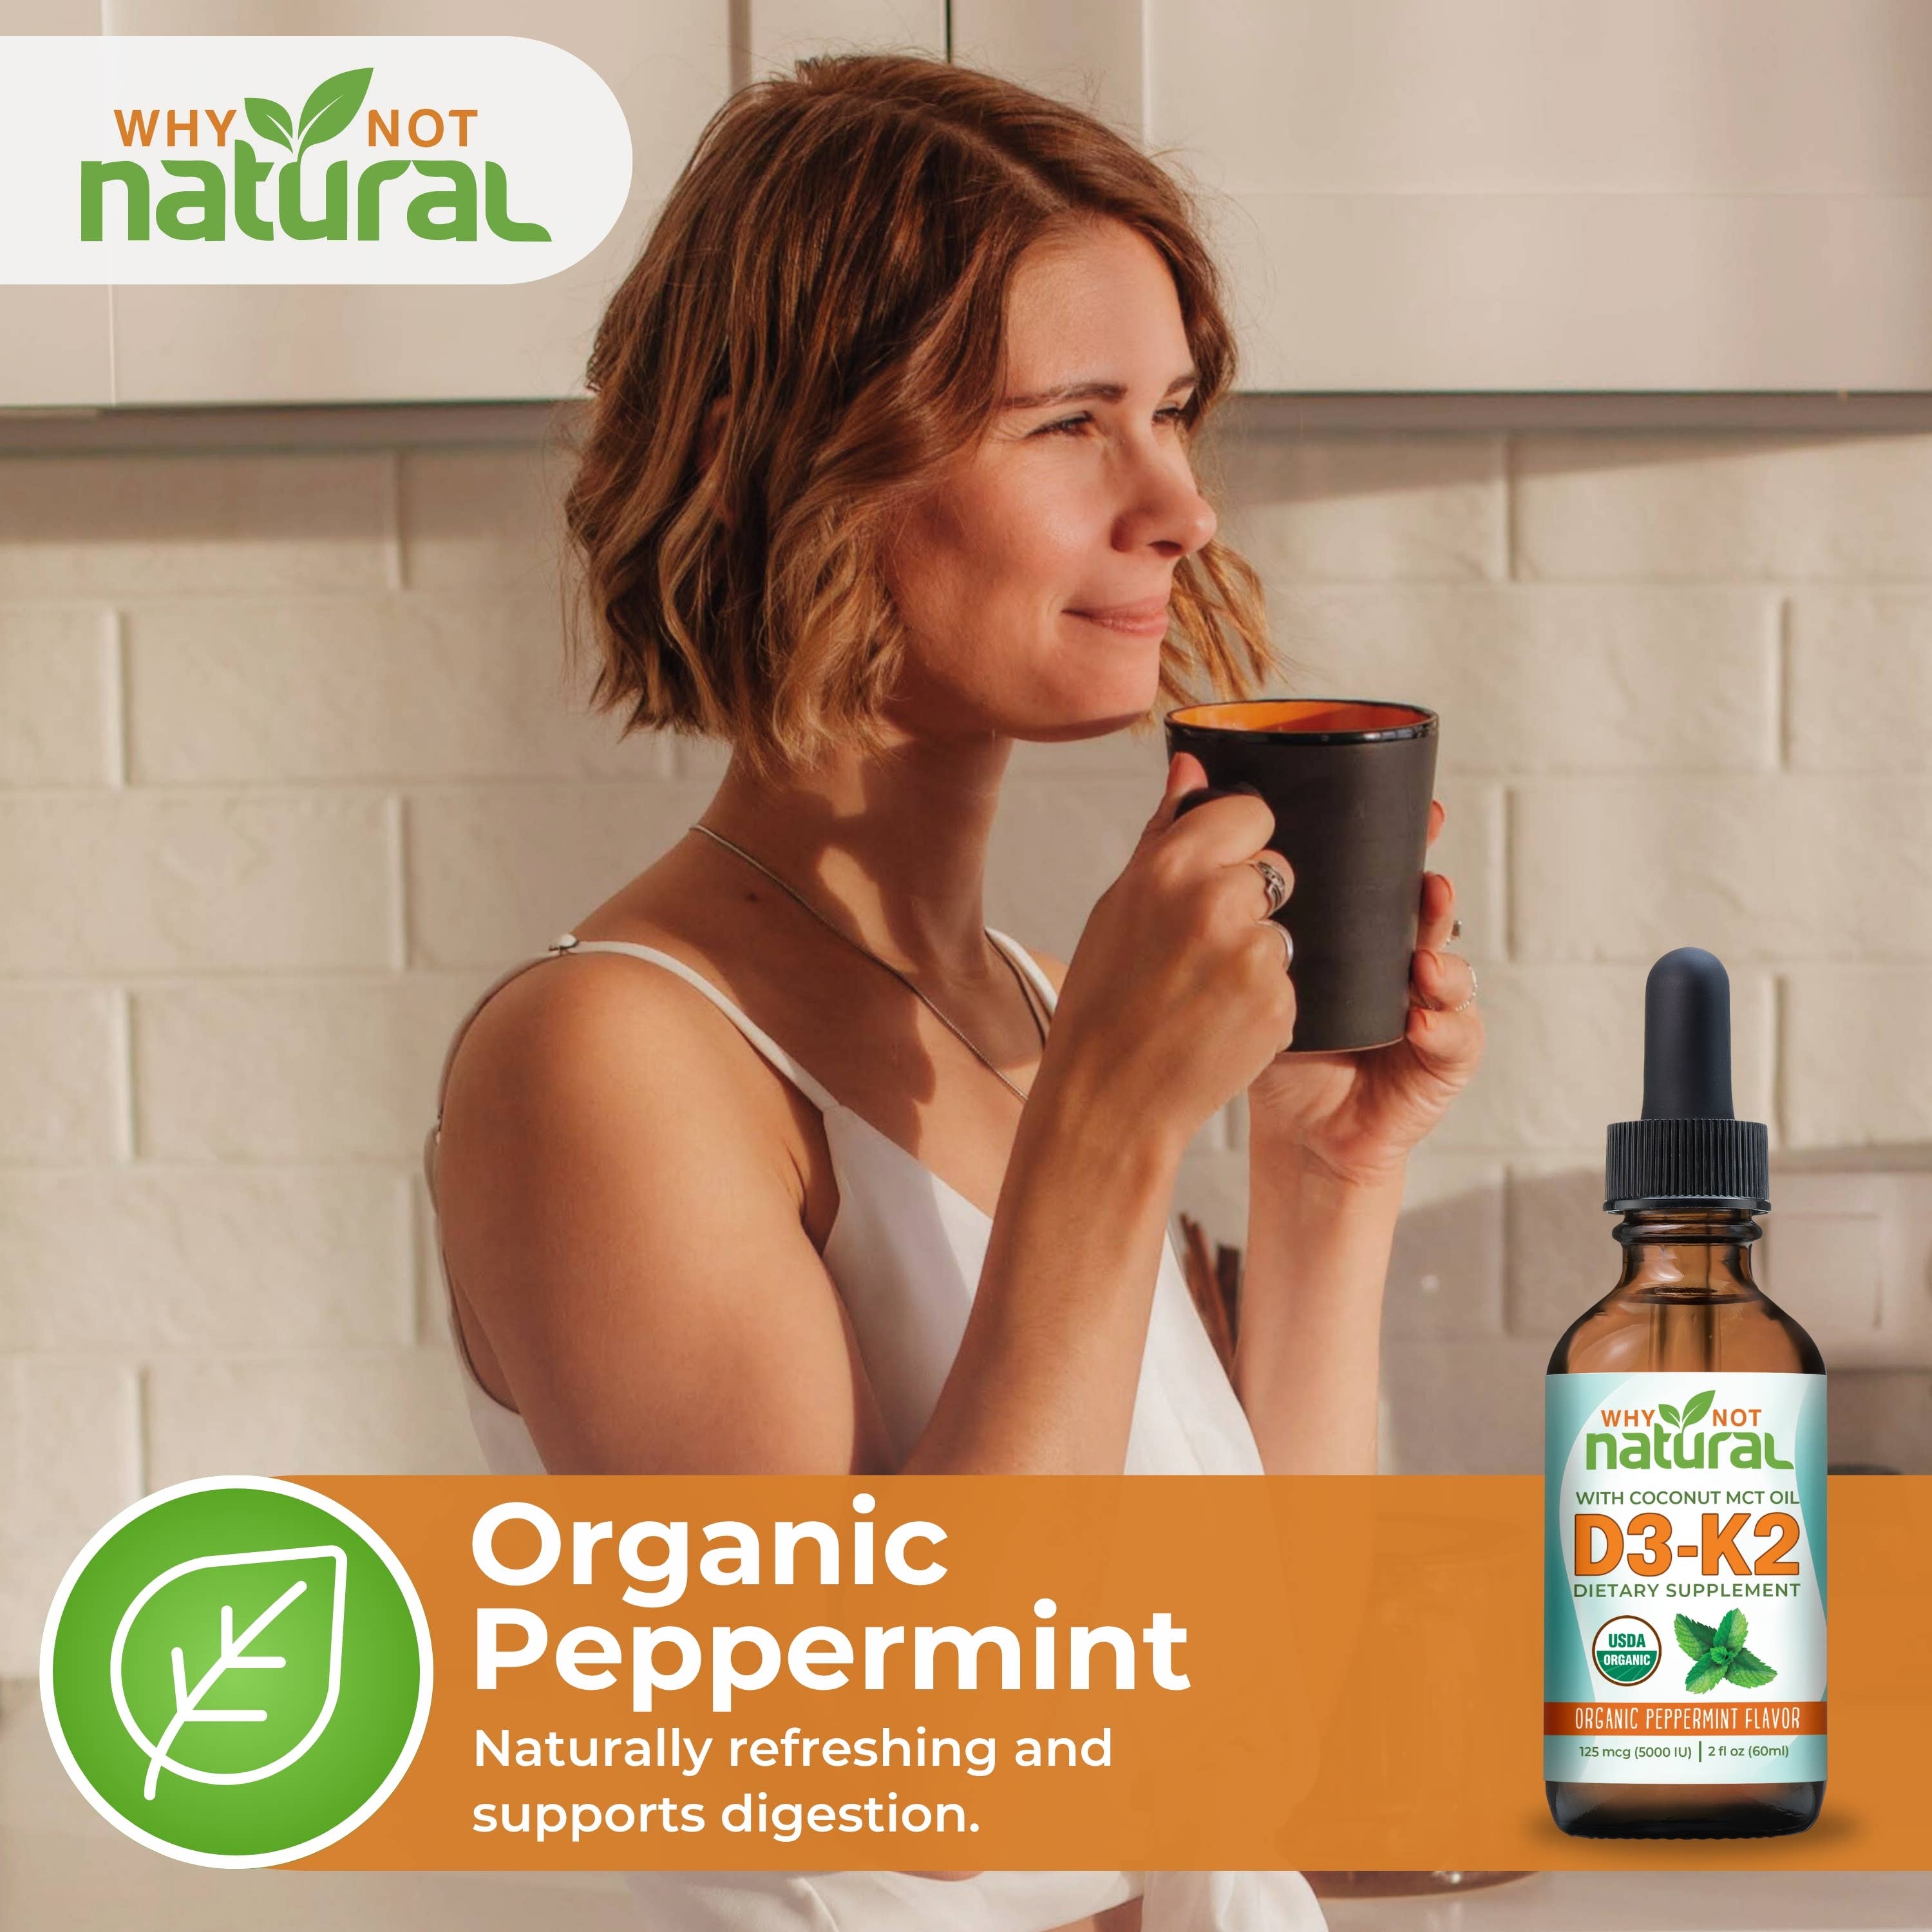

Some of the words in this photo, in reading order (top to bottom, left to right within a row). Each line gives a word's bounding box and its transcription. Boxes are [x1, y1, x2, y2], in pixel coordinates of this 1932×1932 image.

[1600, 1409, 1655, 1427] WHY
[1712, 1408, 1762, 1426] NOT
[1586, 1423, 1795, 1470] natural
[1575, 1491, 1624, 1505] WITH
[1629, 1490, 1721, 1505] COCONUT
[1727, 1490, 1765, 1504] MCT
[1770, 1490, 1800, 1504] OIL
[1574, 1511, 1800, 1577] D3-K2
[1574, 1584, 1660, 1598] DIETARY
[1666, 1583, 1801, 1597] SUPPLEMENT
[1608, 1633, 1646, 1648] USDA
[1604, 1654, 1651, 1665] ORGANIC
[1575, 1707, 1638, 1730] ORGANIC
[1645, 1707, 1738, 1730] PEPPERMINT
[1745, 1707, 1801, 1730] FLAVOR
[1579, 1747, 1599, 1757] 125
[1602, 1748, 1631, 1760] mcg
[1634, 1746, 1671, 1759] (5000
[1674, 1746, 1692, 1759] IU)
[1708, 1747, 1716, 1757] 2
[1718, 1745, 1727, 1757] fl
[1730, 1748, 1745, 1757] oz
[1748, 1745, 1789, 1759] (60ml)
